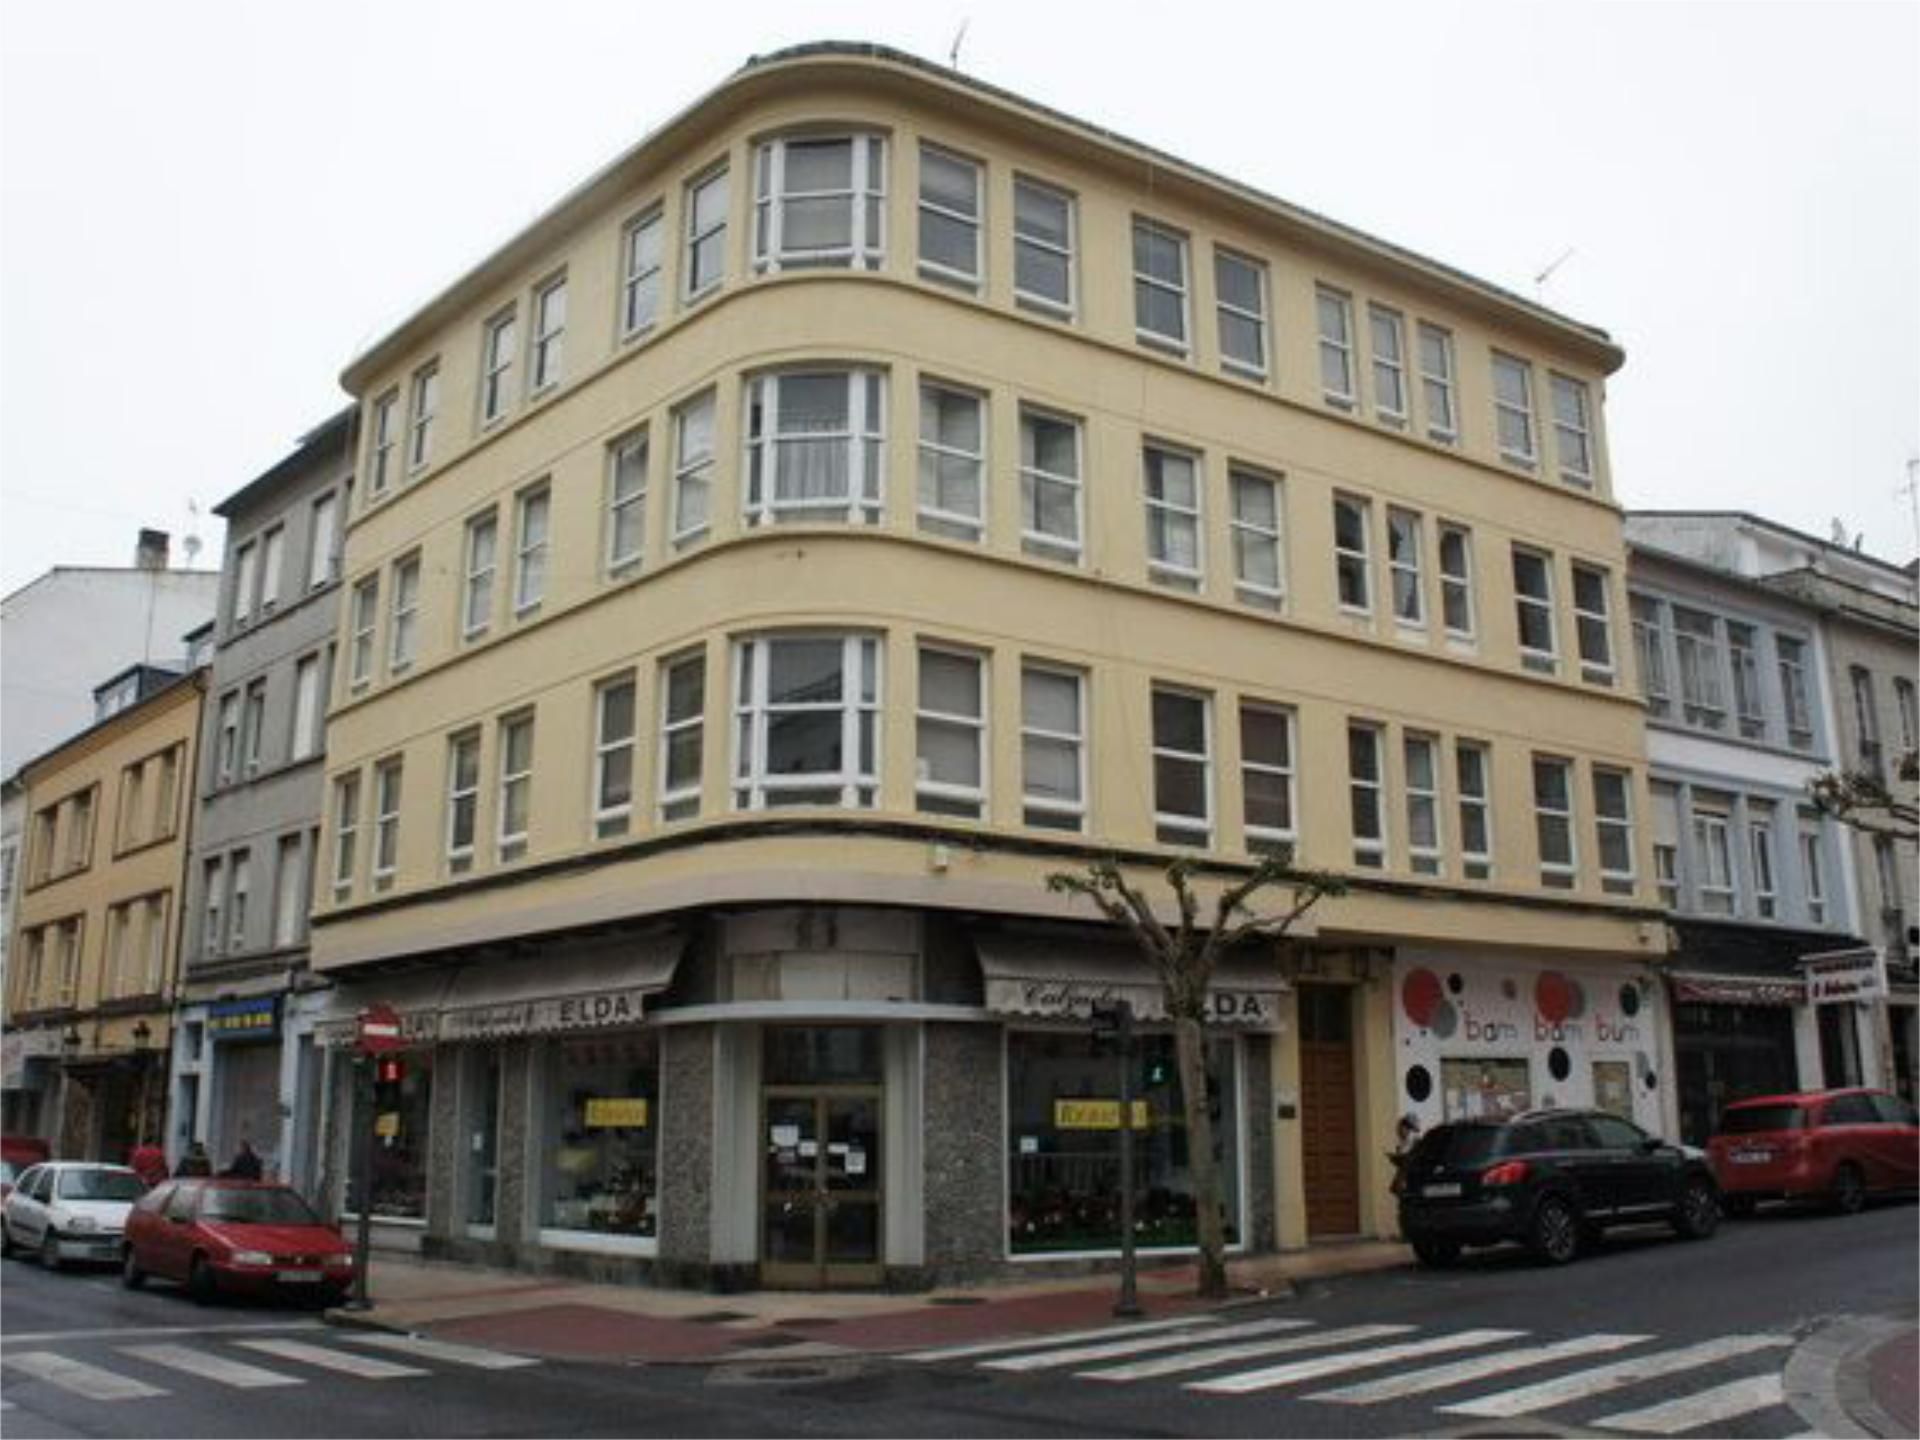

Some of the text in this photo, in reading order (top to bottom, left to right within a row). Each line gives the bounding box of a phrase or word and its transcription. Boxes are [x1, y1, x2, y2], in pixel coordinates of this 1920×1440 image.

[560, 996, 630, 1022] ELDA
[1465, 1011, 1640, 1042] bam bam bum
